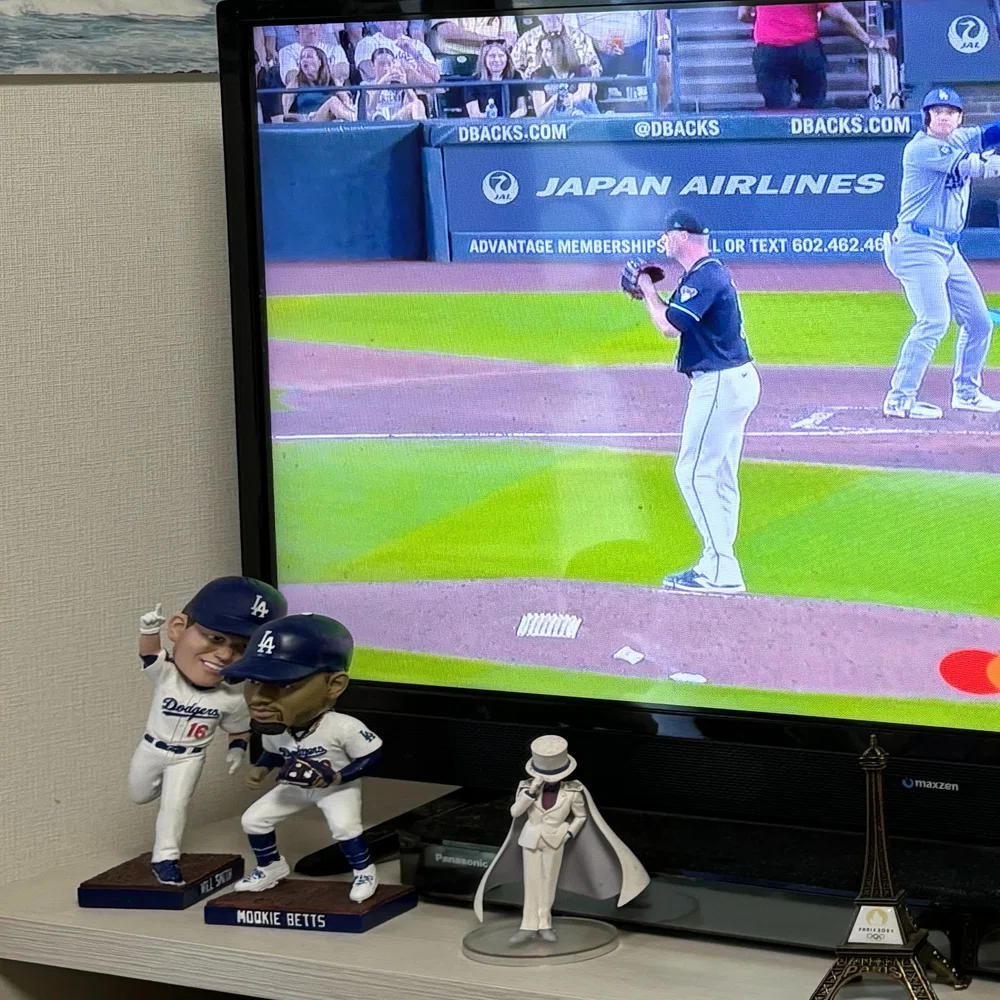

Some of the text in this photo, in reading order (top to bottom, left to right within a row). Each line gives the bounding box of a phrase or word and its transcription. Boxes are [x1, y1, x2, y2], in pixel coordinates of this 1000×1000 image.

[458, 124, 567, 142] DBACKS.COM
[634, 120, 720, 137] @DBACKS
[791, 116, 911, 135] DBACKS.COM
[535, 173, 886, 196] JAPAN AIRLINES
[469, 238, 554, 254] ADVANTAGE
[557, 238, 665, 254] MEMBERSHIPS
[724, 238, 746, 252] OR
[749, 238, 788, 252] TEXT
[162, 697, 220, 721] Dodgers
[187, 722, 209, 739] 16
[914, 779, 959, 791] maxzen
[435, 853, 488, 868] Panasonic
[236, 909, 326, 928] MOOKIE BETTS
